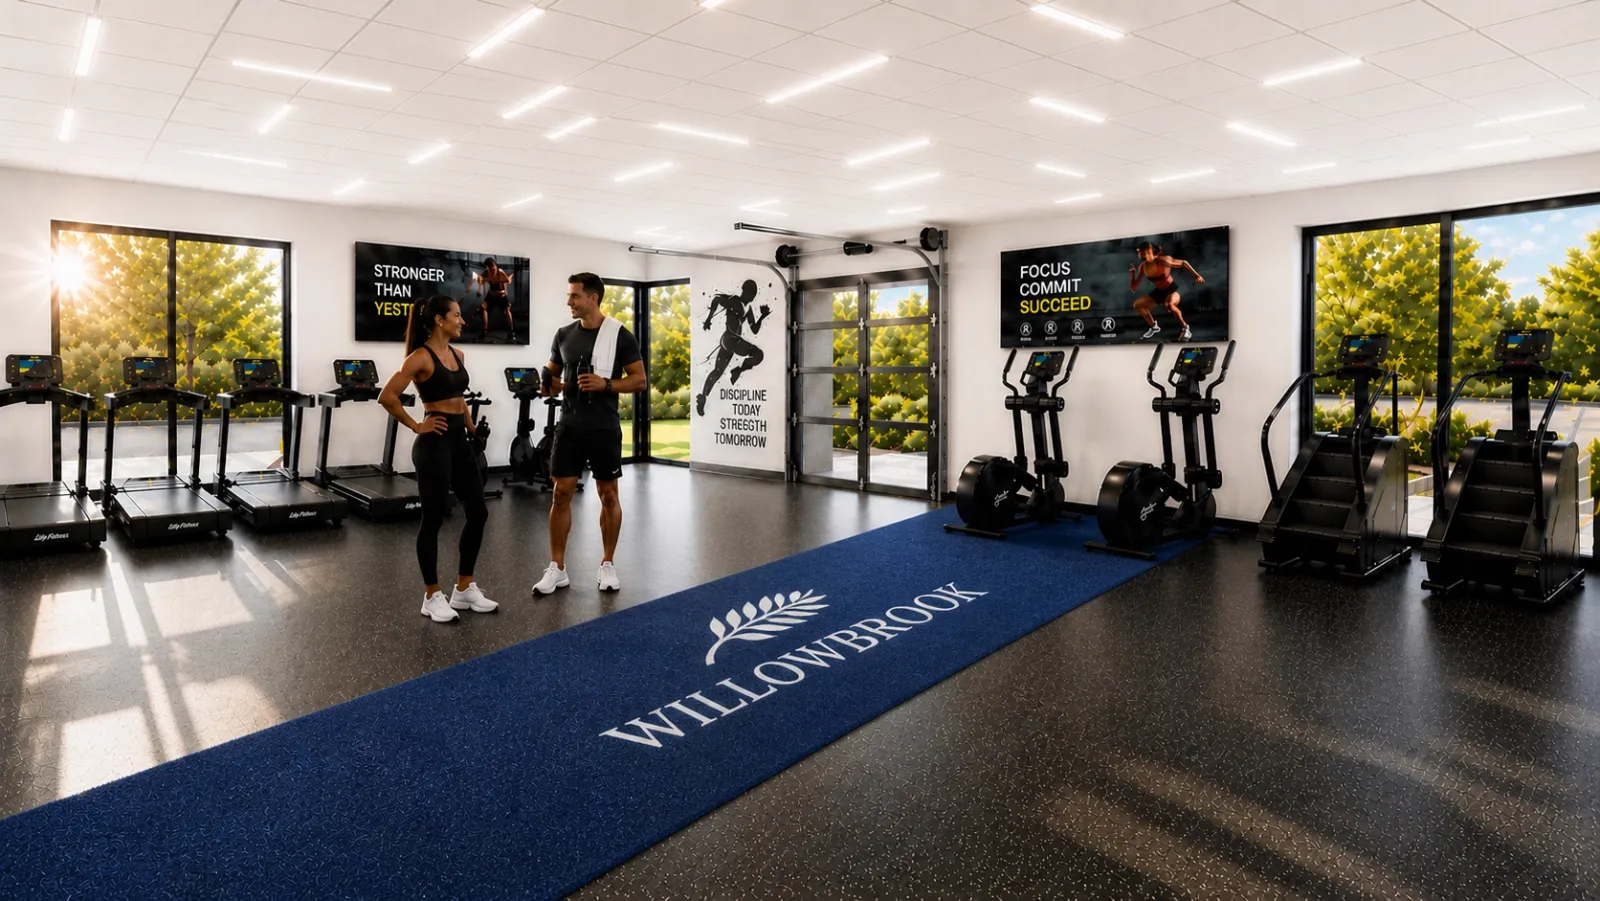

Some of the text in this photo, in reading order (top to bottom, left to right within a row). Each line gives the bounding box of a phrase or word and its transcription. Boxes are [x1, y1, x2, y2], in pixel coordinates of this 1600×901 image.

[374, 264, 445, 282] STRONGER
[1020, 261, 1071, 279] FOCUS
[374, 282, 412, 297] THAN
[1020, 278, 1082, 296] COMMIT
[1020, 296, 1091, 314] SUCCEED
[720, 388, 767, 401] DISCIPLINE
[732, 403, 761, 416] TODAY
[714, 432, 767, 448] TOMORROW
[599, 582, 988, 747] WILLOWBROOK
